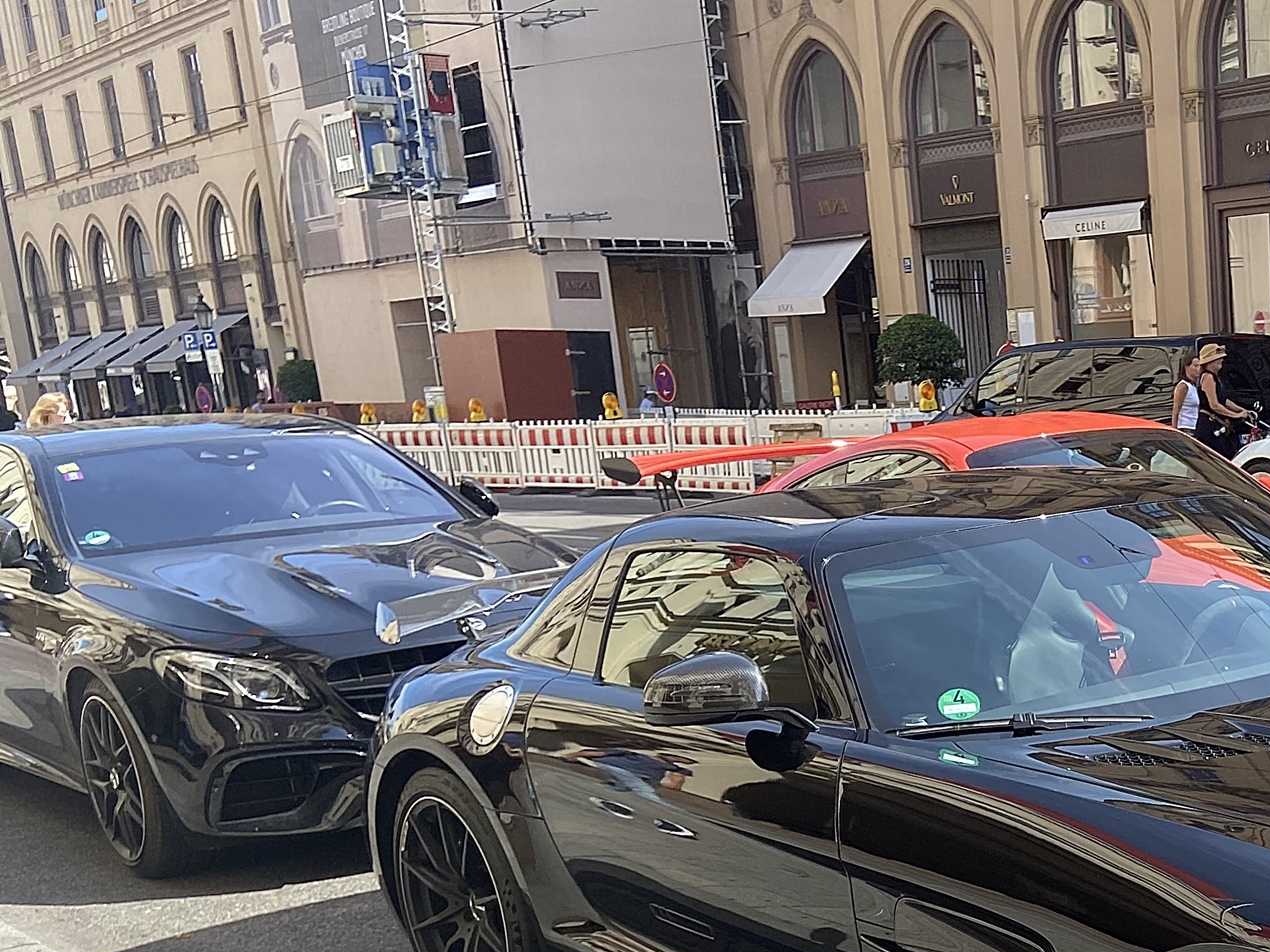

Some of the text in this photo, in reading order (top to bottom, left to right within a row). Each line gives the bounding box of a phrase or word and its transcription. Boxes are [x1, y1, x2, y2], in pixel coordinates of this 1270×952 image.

[940, 191, 975, 206] VALMONT
[1074, 220, 1106, 233] CELINE
[953, 690, 965, 704] 4
